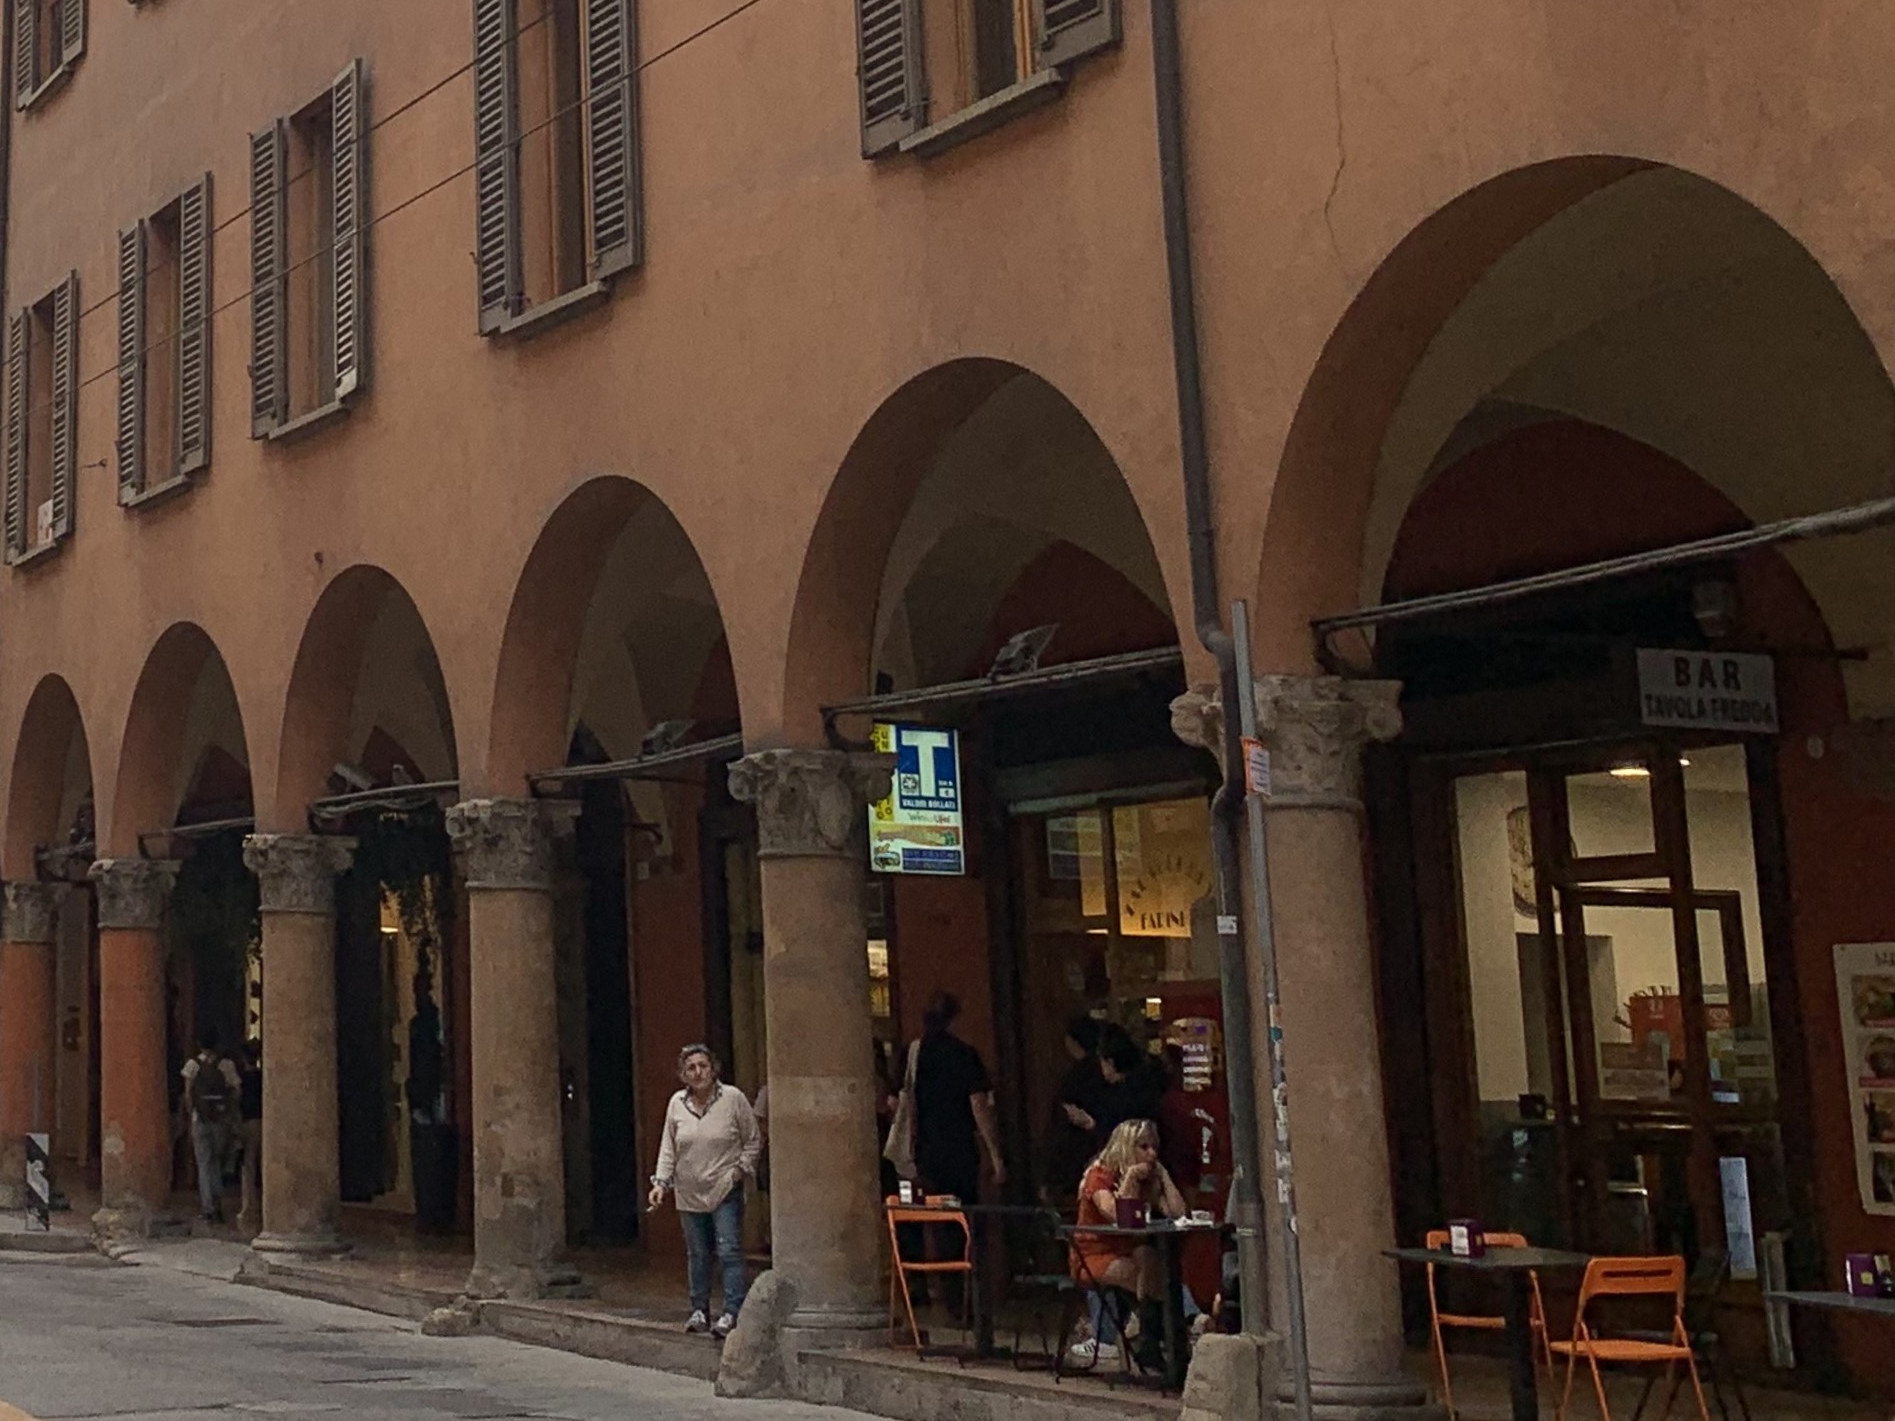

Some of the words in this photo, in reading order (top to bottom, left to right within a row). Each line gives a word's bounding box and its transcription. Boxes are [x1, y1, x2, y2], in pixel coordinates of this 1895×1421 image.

[1674, 656, 1741, 690] BAR
[1644, 693, 1706, 720] TAVOLA
[1710, 697, 1775, 725] FREDDA
[901, 730, 950, 797] T
